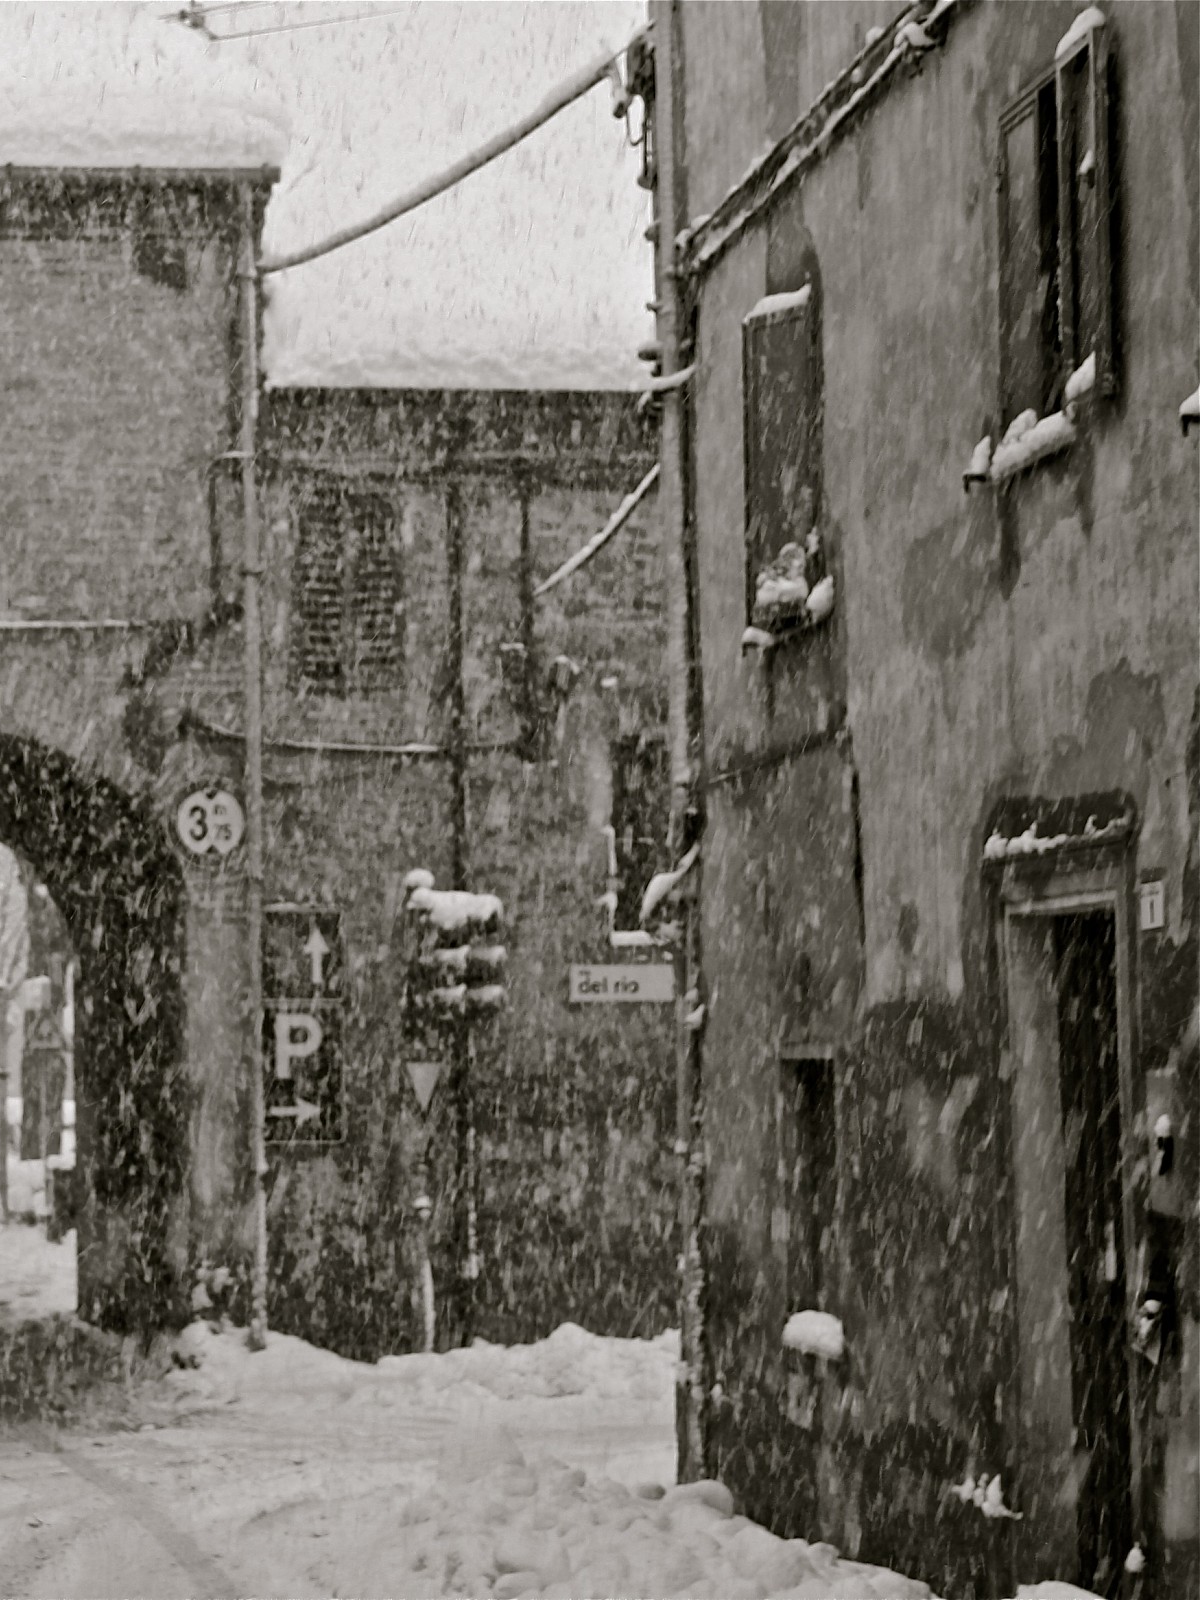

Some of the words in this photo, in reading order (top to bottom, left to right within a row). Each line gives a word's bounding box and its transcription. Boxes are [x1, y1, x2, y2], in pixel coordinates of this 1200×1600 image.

[189, 806, 207, 841] 3
[578, 977, 609, 994] del
[613, 977, 640, 993] rio
[275, 1013, 324, 1079] P
